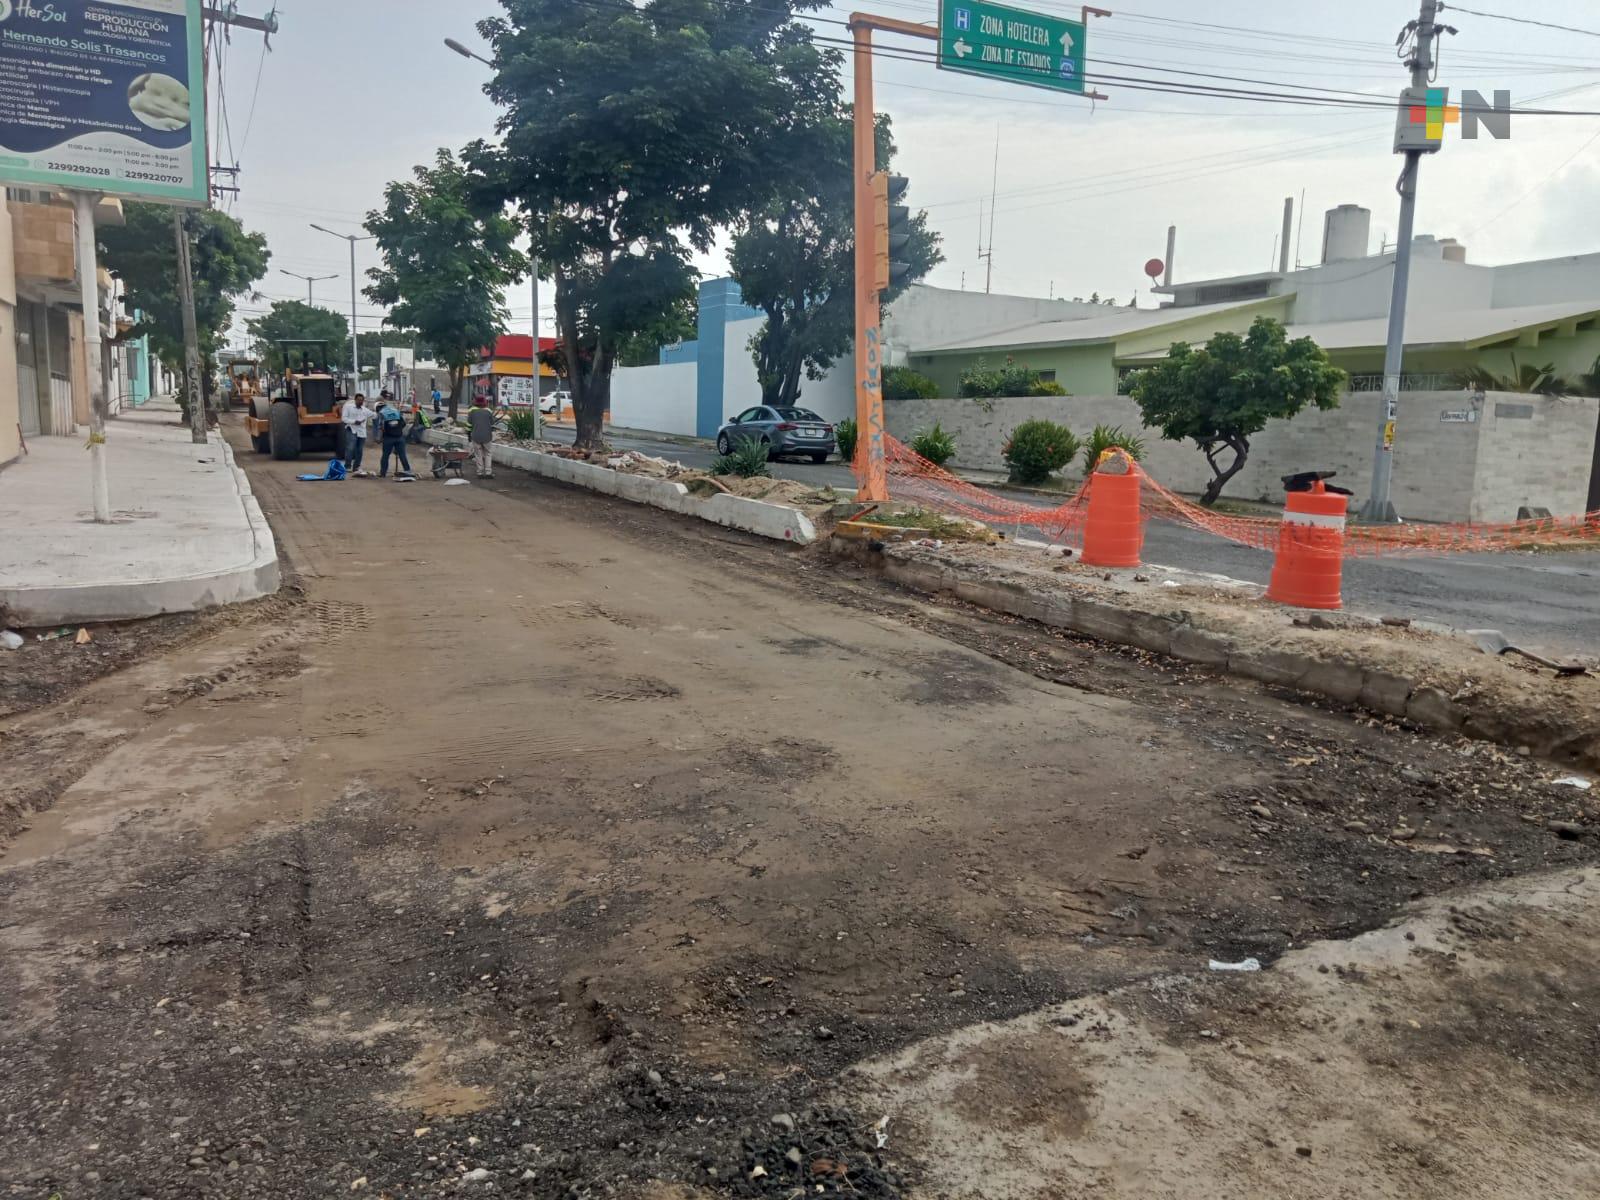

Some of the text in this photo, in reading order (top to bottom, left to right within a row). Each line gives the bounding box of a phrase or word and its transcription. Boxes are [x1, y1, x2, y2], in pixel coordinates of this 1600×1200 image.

[16, 0, 67, 22] HerSol
[84, 11, 169, 33] REPRODUCCIÓN
[101, 23, 150, 38] HUMANA
[979, 15, 1050, 46] ZONA HOTELERA
[3, 29, 167, 62] Hernando Solis Trasancos
[981, 45, 1052, 74] ZONA DE ESTADIOS
[90, 77, 113, 85] riesgo
[47, 162, 184, 184] 2299292028 2299220707
